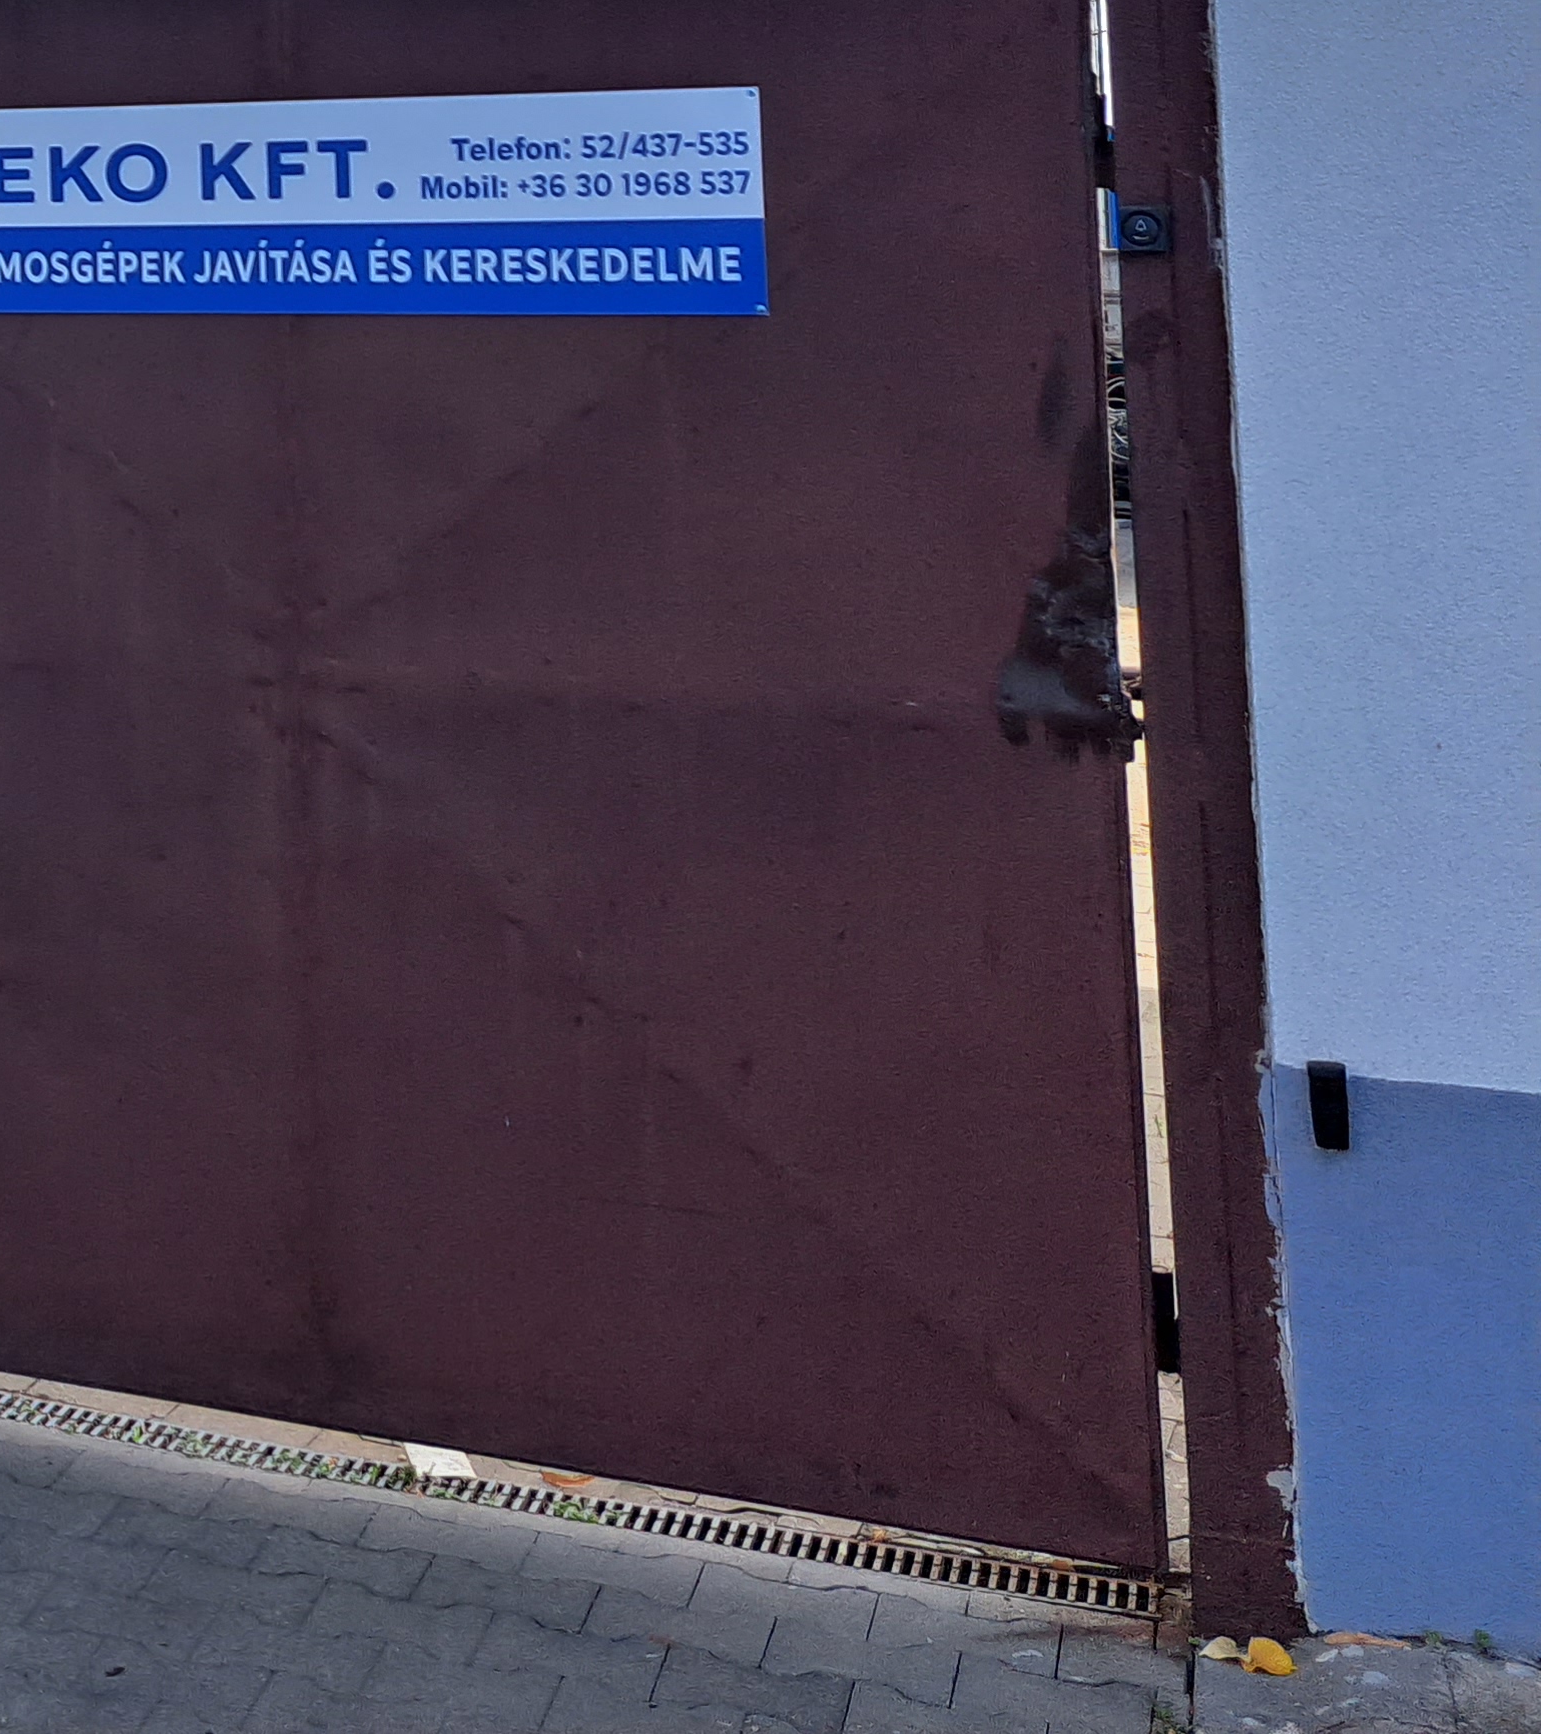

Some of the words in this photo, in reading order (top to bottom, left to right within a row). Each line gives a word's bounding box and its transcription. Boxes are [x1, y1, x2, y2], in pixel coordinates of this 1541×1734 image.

[450, 134, 572, 162] Telefon:
[579, 130, 750, 161] 52/437-535
[199, 138, 396, 201] KFT.
[419, 173, 509, 200] Mobil:
[517, 172, 567, 199] +36
[575, 171, 613, 198] 30
[621, 170, 692, 197] 1968
[699, 169, 751, 196] 537
[192, 238, 357, 284] JAVÍTÁSA
[367, 237, 413, 284] ÉS
[423, 246, 743, 283] KERESKEDELME
